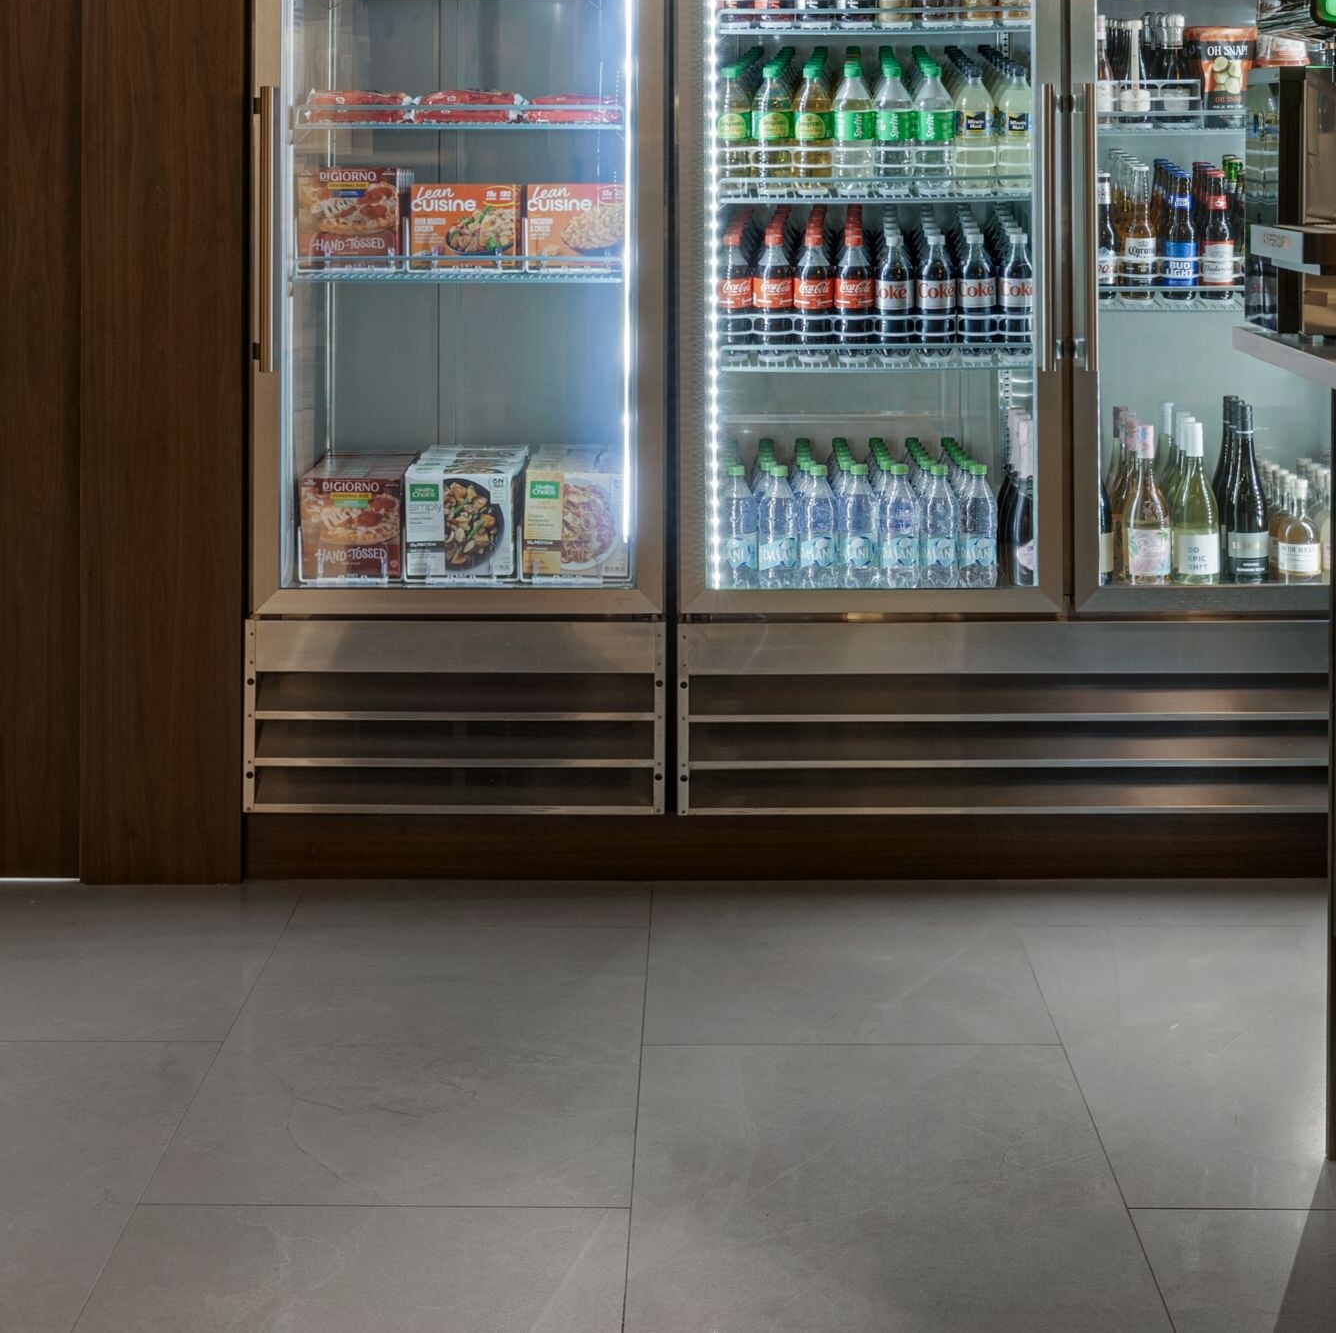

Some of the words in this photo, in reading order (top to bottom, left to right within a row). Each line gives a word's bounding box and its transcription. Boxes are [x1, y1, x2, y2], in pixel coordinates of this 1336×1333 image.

[1207, 46, 1222, 56] OH
[1223, 45, 1248, 56] SNAP!
[854, 113, 863, 138] Sprite
[890, 113, 899, 138] Sprite
[926, 113, 935, 139] Sprite
[416, 186, 455, 201] Lean
[533, 186, 570, 201] Lean
[1166, 268, 1194, 277] LIGHT
[1169, 261, 1190, 269] BUD
[917, 282, 955, 299] Coke
[958, 281, 994, 298] Coke
[408, 502, 442, 514] simply
